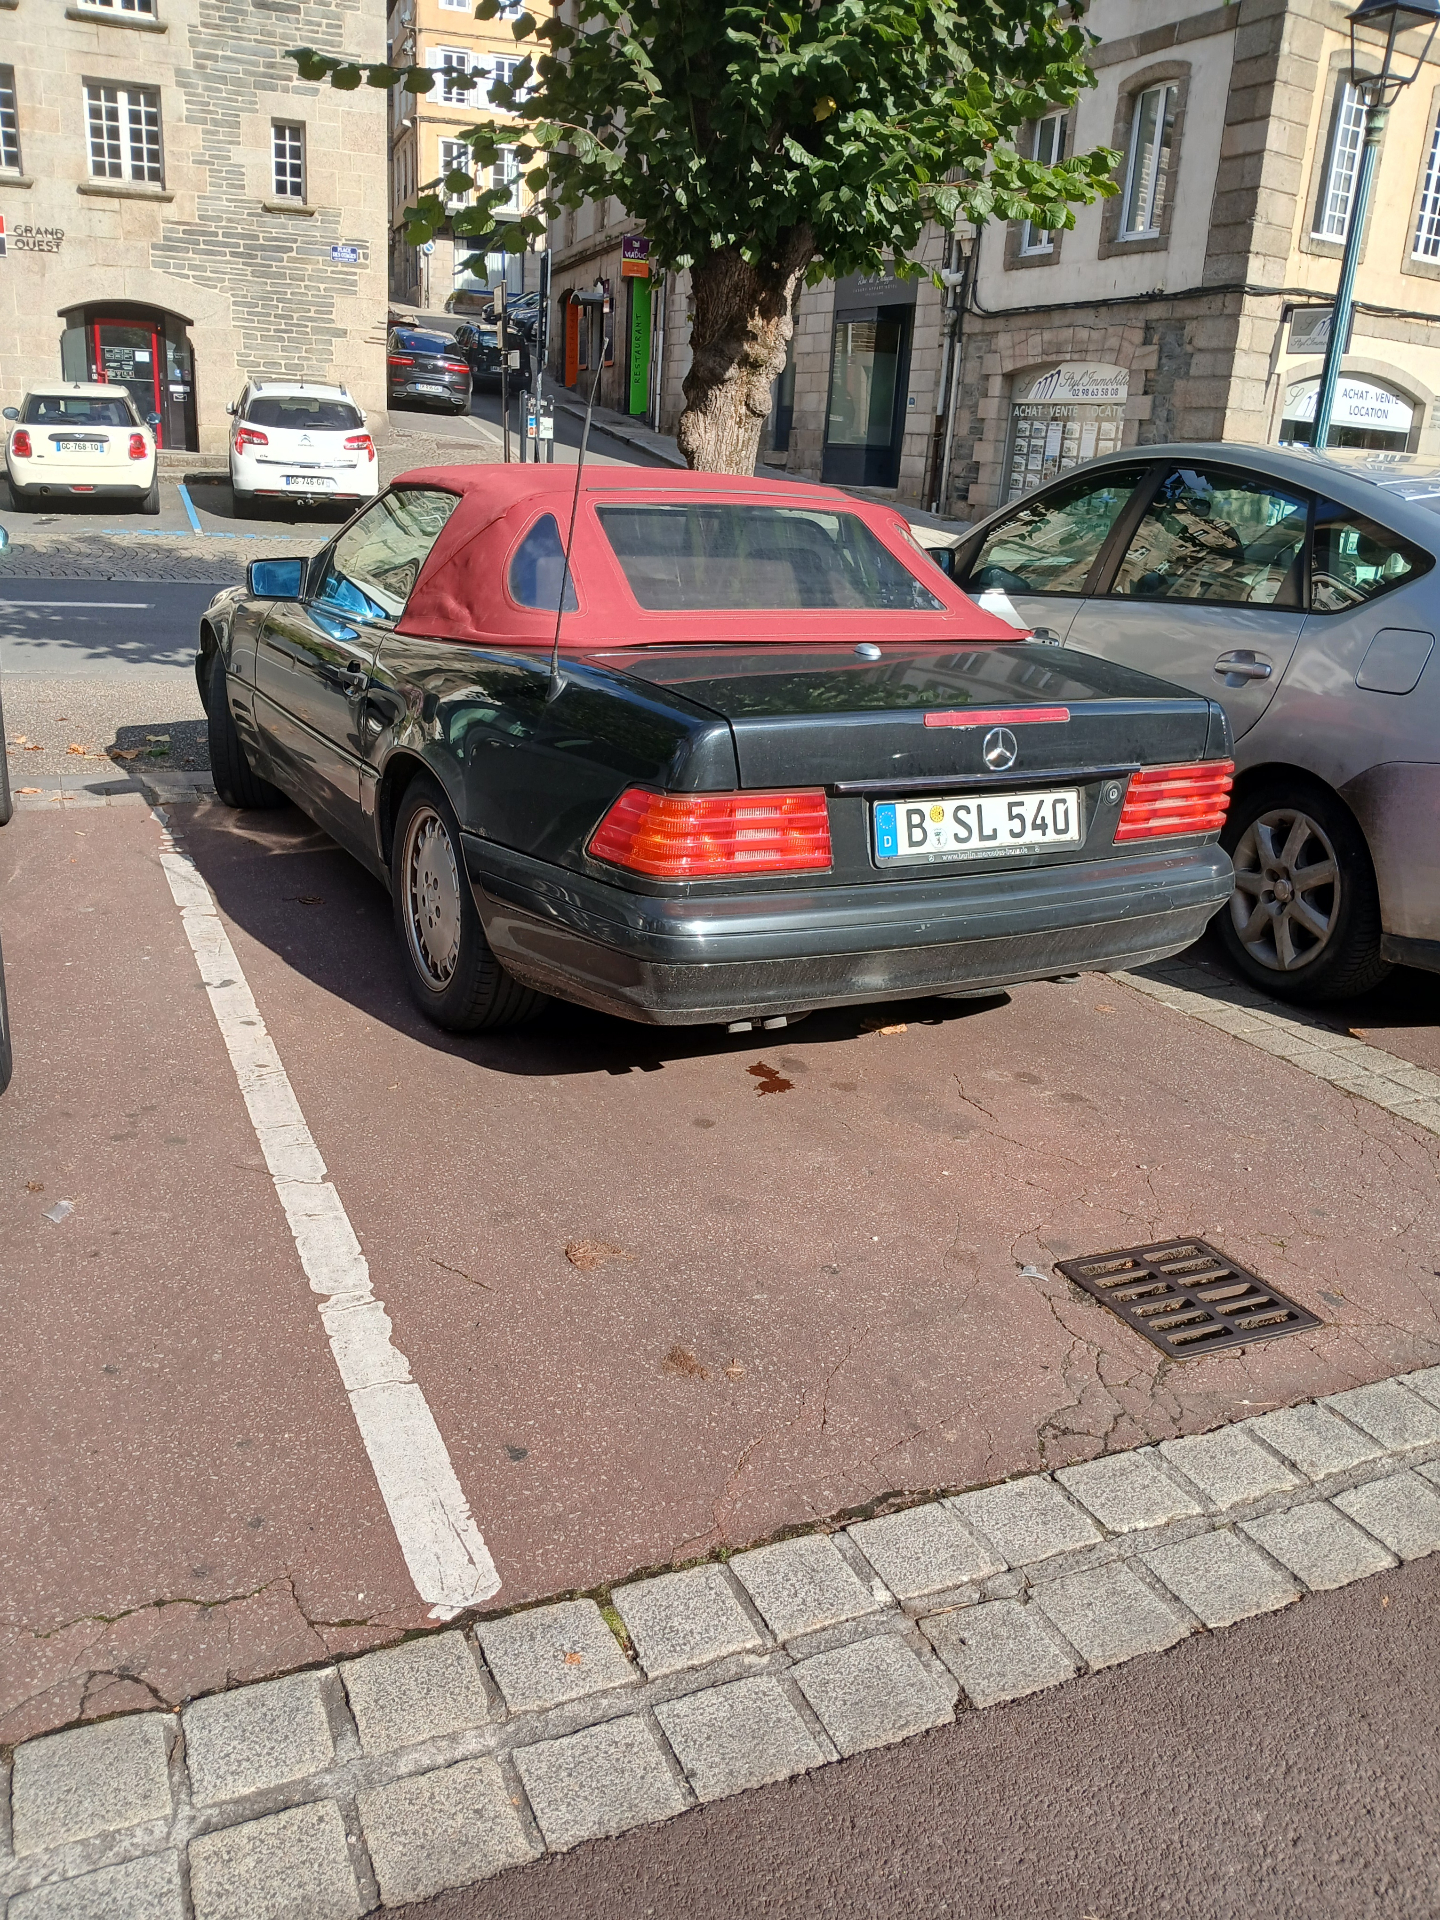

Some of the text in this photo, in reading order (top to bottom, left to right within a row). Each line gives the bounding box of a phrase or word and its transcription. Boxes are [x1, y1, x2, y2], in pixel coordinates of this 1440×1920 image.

[13, 225, 65, 239] GRAND
[15, 239, 62, 252] OUEST
[634, 313, 642, 384] RESTAURANT
[1071, 388, 1119, 397] 02 98 63 58 08
[1342, 388, 1400, 405] ACHAT VENTE
[1013, 405, 1043, 417] ACHAT
[1049, 405, 1078, 417] VENTE
[1349, 405, 1389, 419] LOCATION
[883, 798, 1070, 848] D B SL 540
